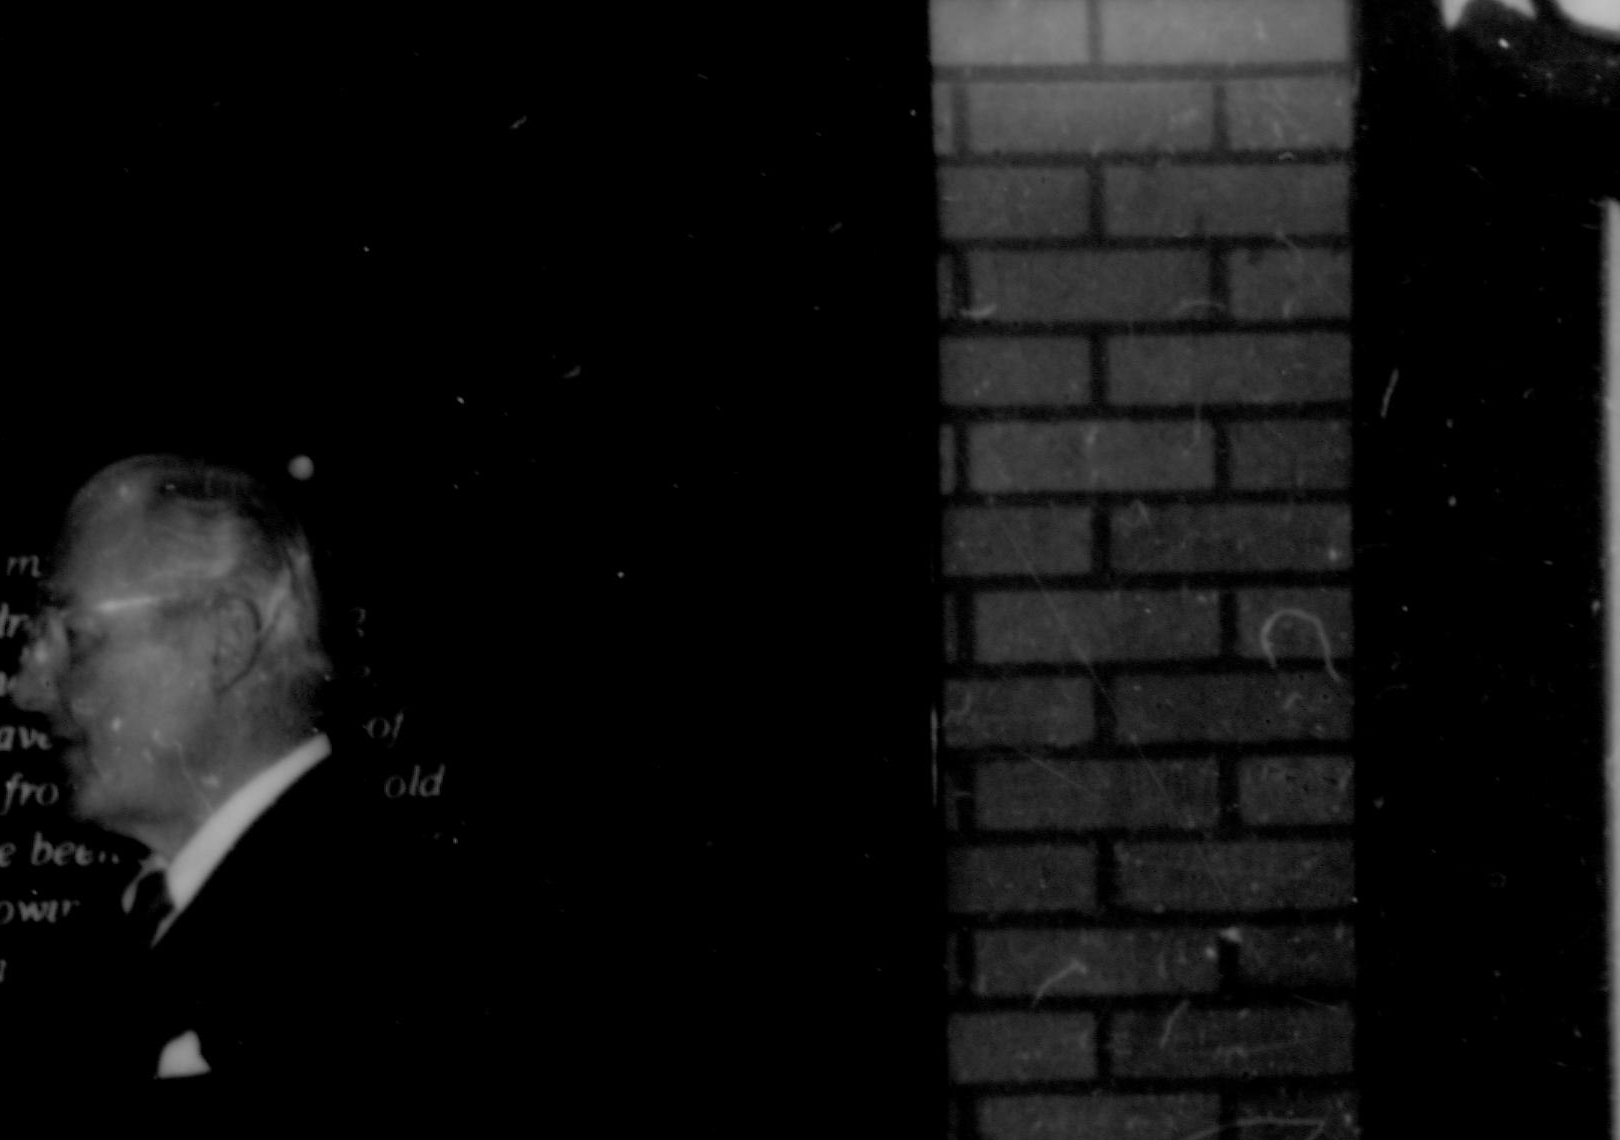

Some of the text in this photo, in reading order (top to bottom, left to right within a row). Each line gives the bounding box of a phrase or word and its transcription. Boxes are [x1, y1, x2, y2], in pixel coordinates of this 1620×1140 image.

[6, 554, 44, 580] m
[0, 771, 61, 816] fro
[382, 761, 448, 800] old
